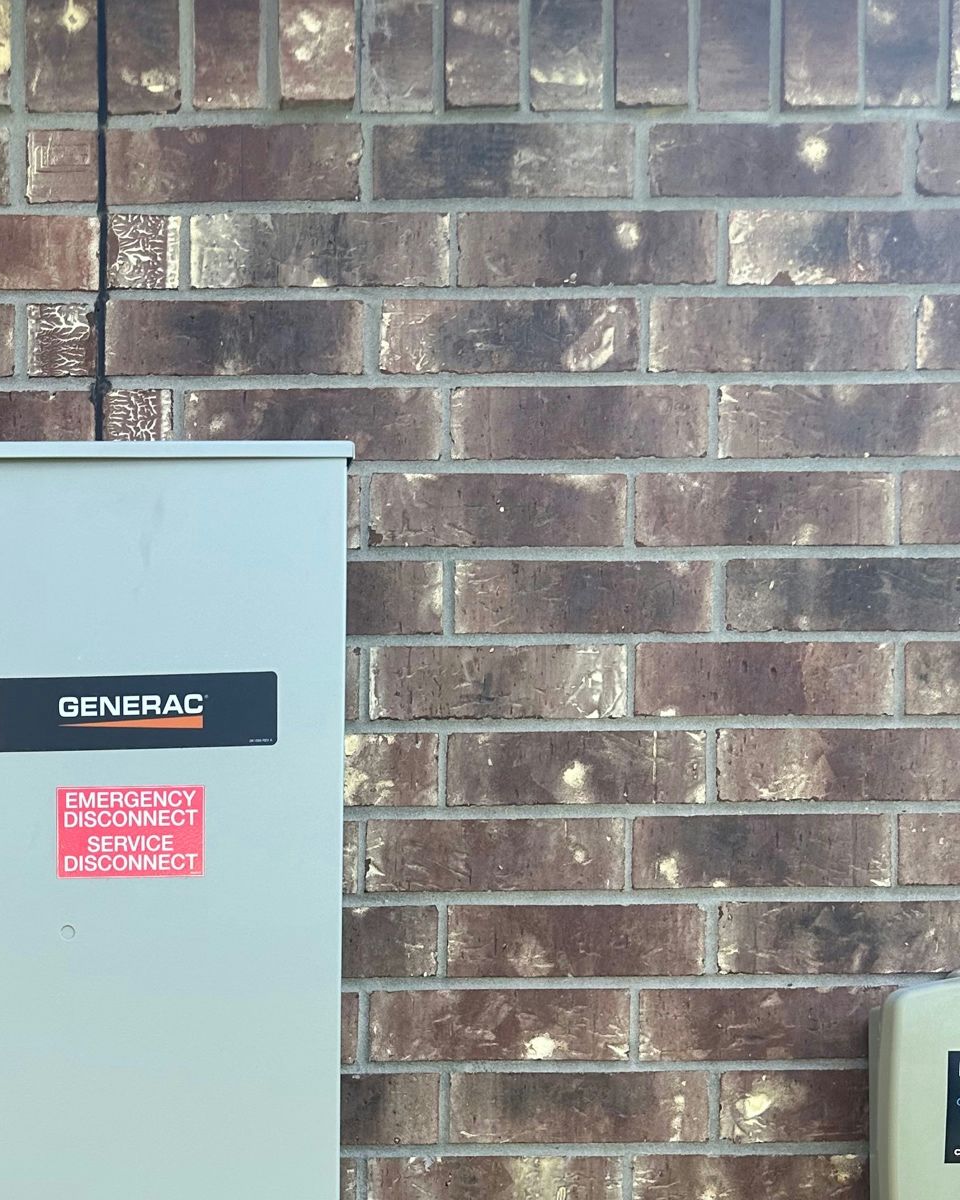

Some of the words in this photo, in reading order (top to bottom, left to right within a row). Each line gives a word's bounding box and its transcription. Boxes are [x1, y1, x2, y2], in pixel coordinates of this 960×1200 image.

[58, 693, 204, 718] GENERAC
[65, 790, 197, 809] EMERGENCY
[63, 809, 198, 827] DISCONNECT
[87, 835, 174, 852] SERVICE
[63, 853, 198, 872] DISCONNECT
